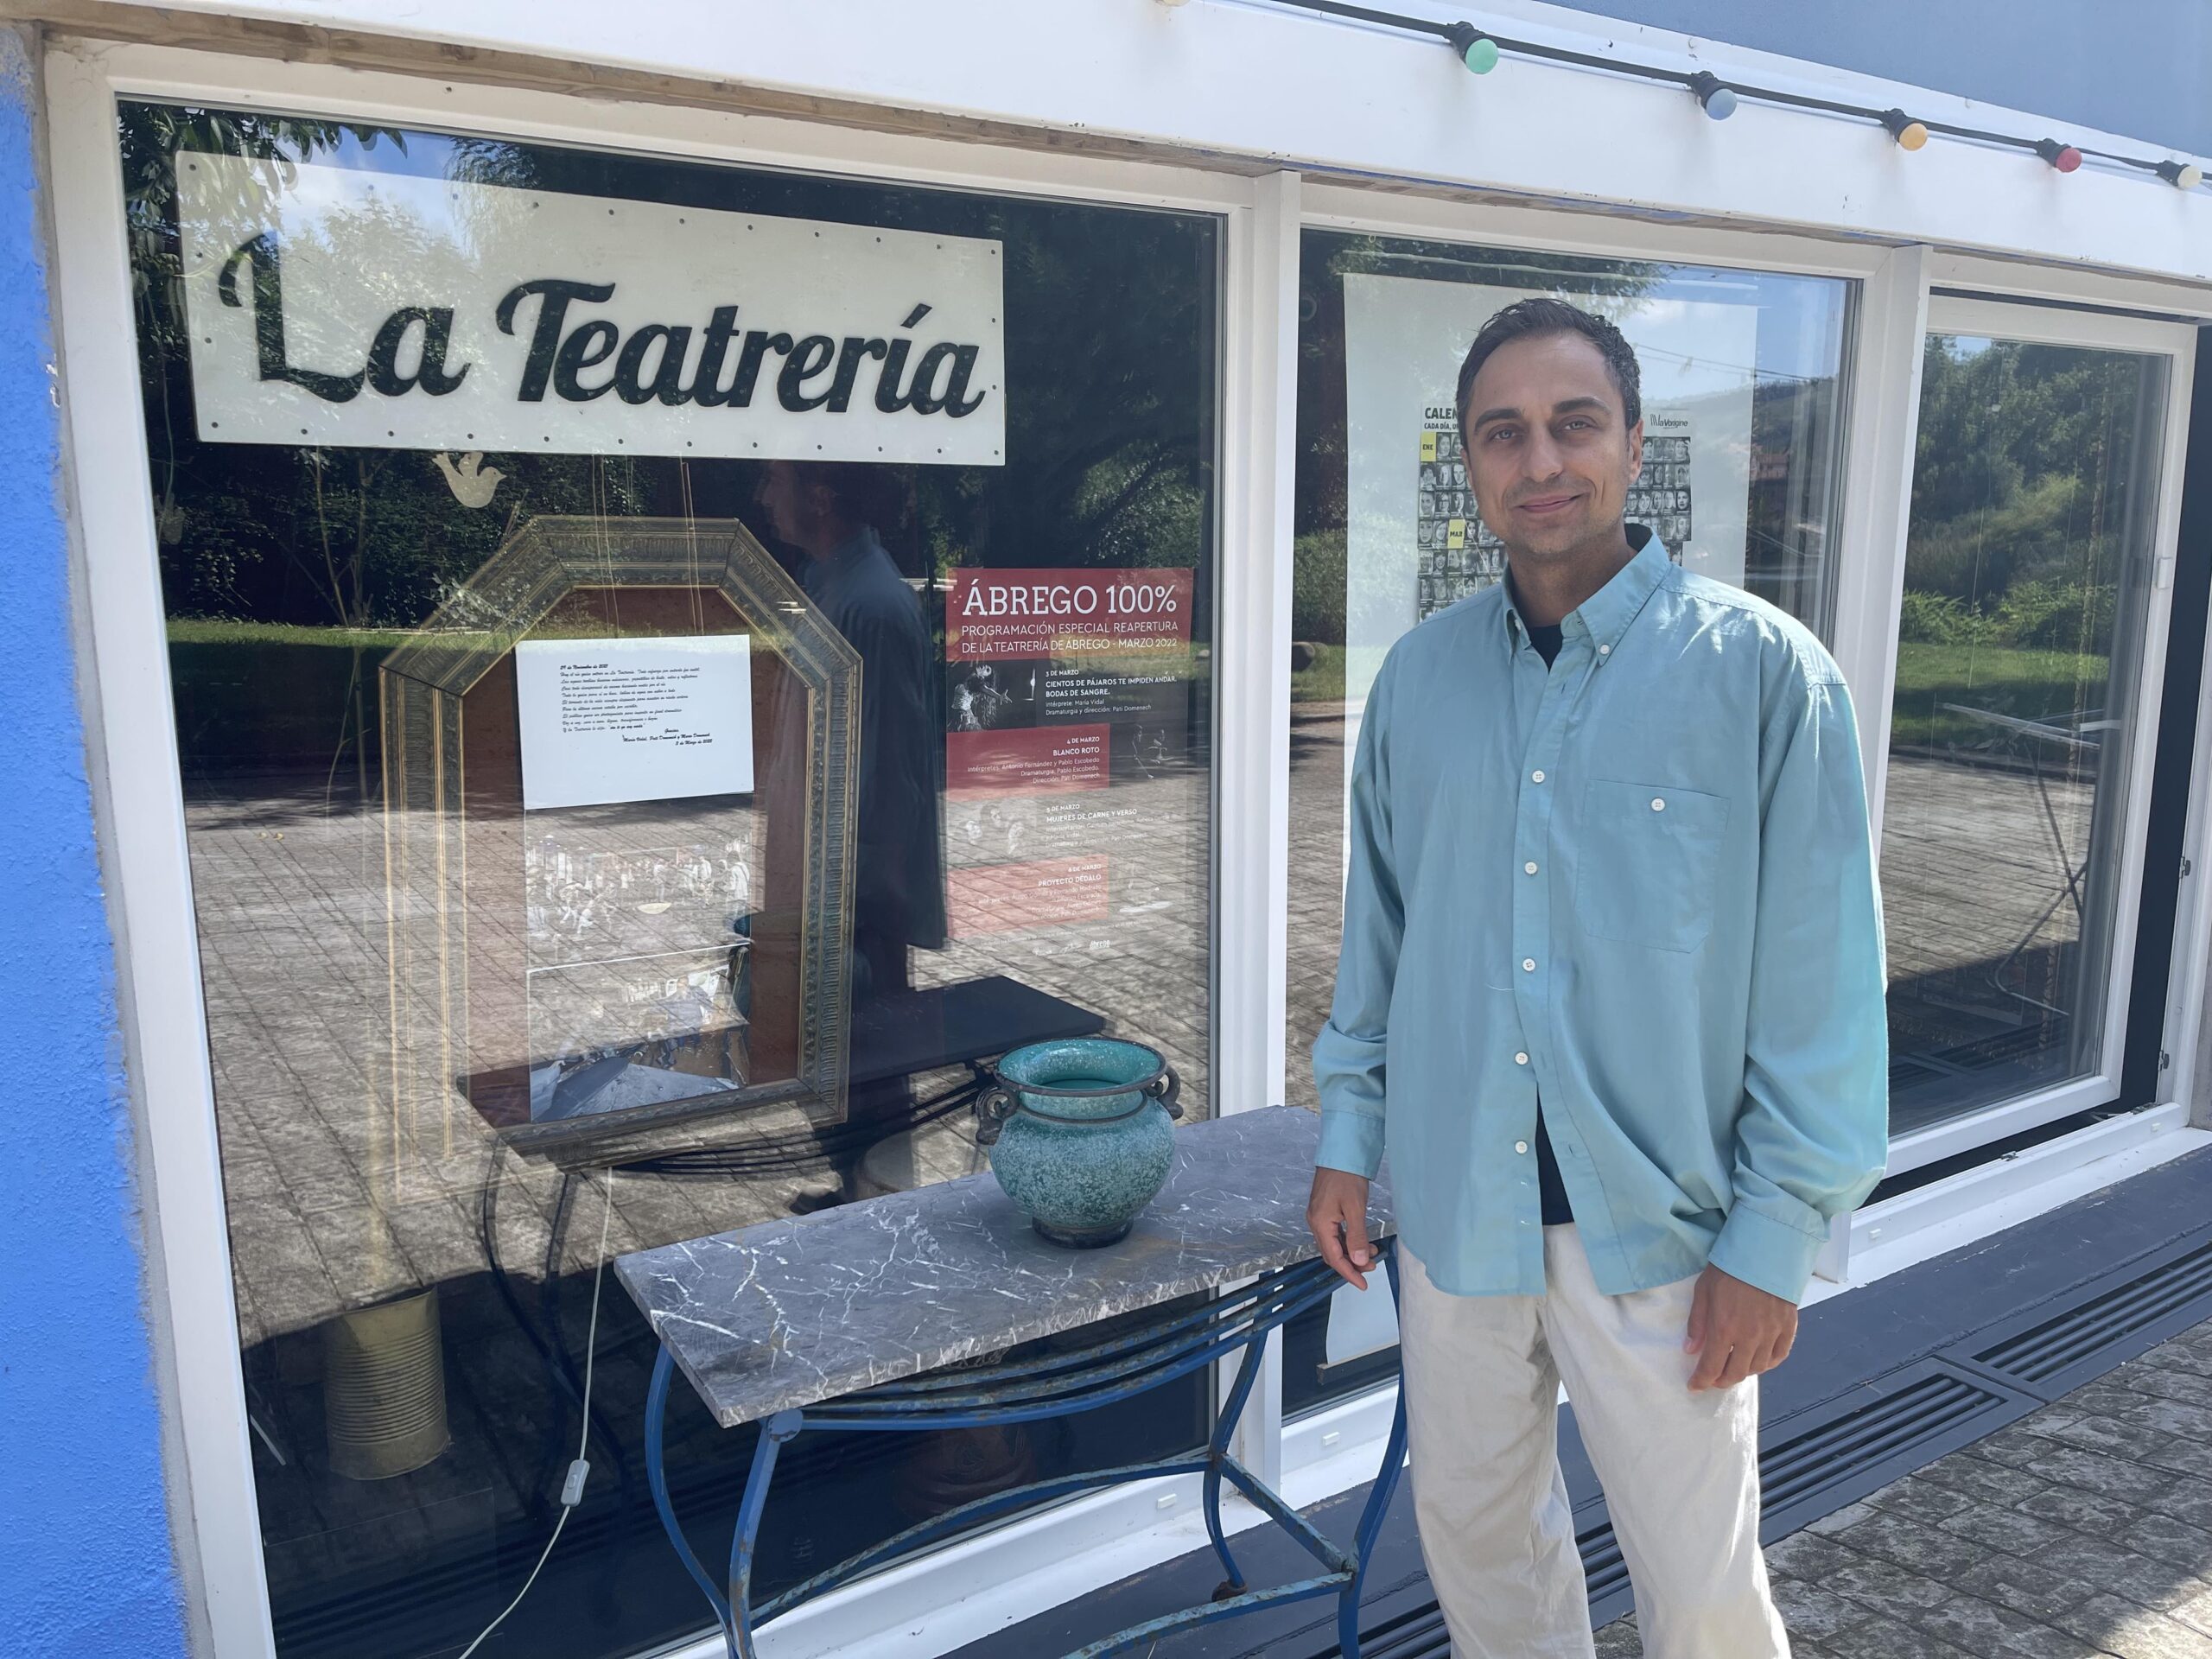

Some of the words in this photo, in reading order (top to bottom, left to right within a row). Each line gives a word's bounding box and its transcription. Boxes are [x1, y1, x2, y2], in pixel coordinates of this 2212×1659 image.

[219, 231, 471, 403] La
[496, 279, 986, 417] Teatrería
[962, 578, 1097, 616] ÁBREGO
[1106, 585, 1177, 613] 100%
[962, 621, 1055, 636] PROGRAMACIÓN
[1059, 623, 1110, 634] ESPECIAL
[1113, 621, 1178, 632] REAPERTURA
[962, 642, 977, 653] DE
[979, 642, 993, 653] LA
[994, 638, 1049, 652] TEATRERÍA
[1051, 640, 1064, 651] DE
[1065, 637, 1110, 650] ÁBREGO
[1118, 638, 1153, 648] MARZO
[1155, 638, 1177, 647] 2022
[1087, 677, 1117, 686] PÁJAROS
[1053, 748, 1080, 756] BLANCO
[1046, 815, 1076, 823] MUJERES
[1088, 811, 1110, 819] CARNE
[1038, 877, 1074, 887] PROYECTO
[1075, 874, 1101, 882] DÉDALO
